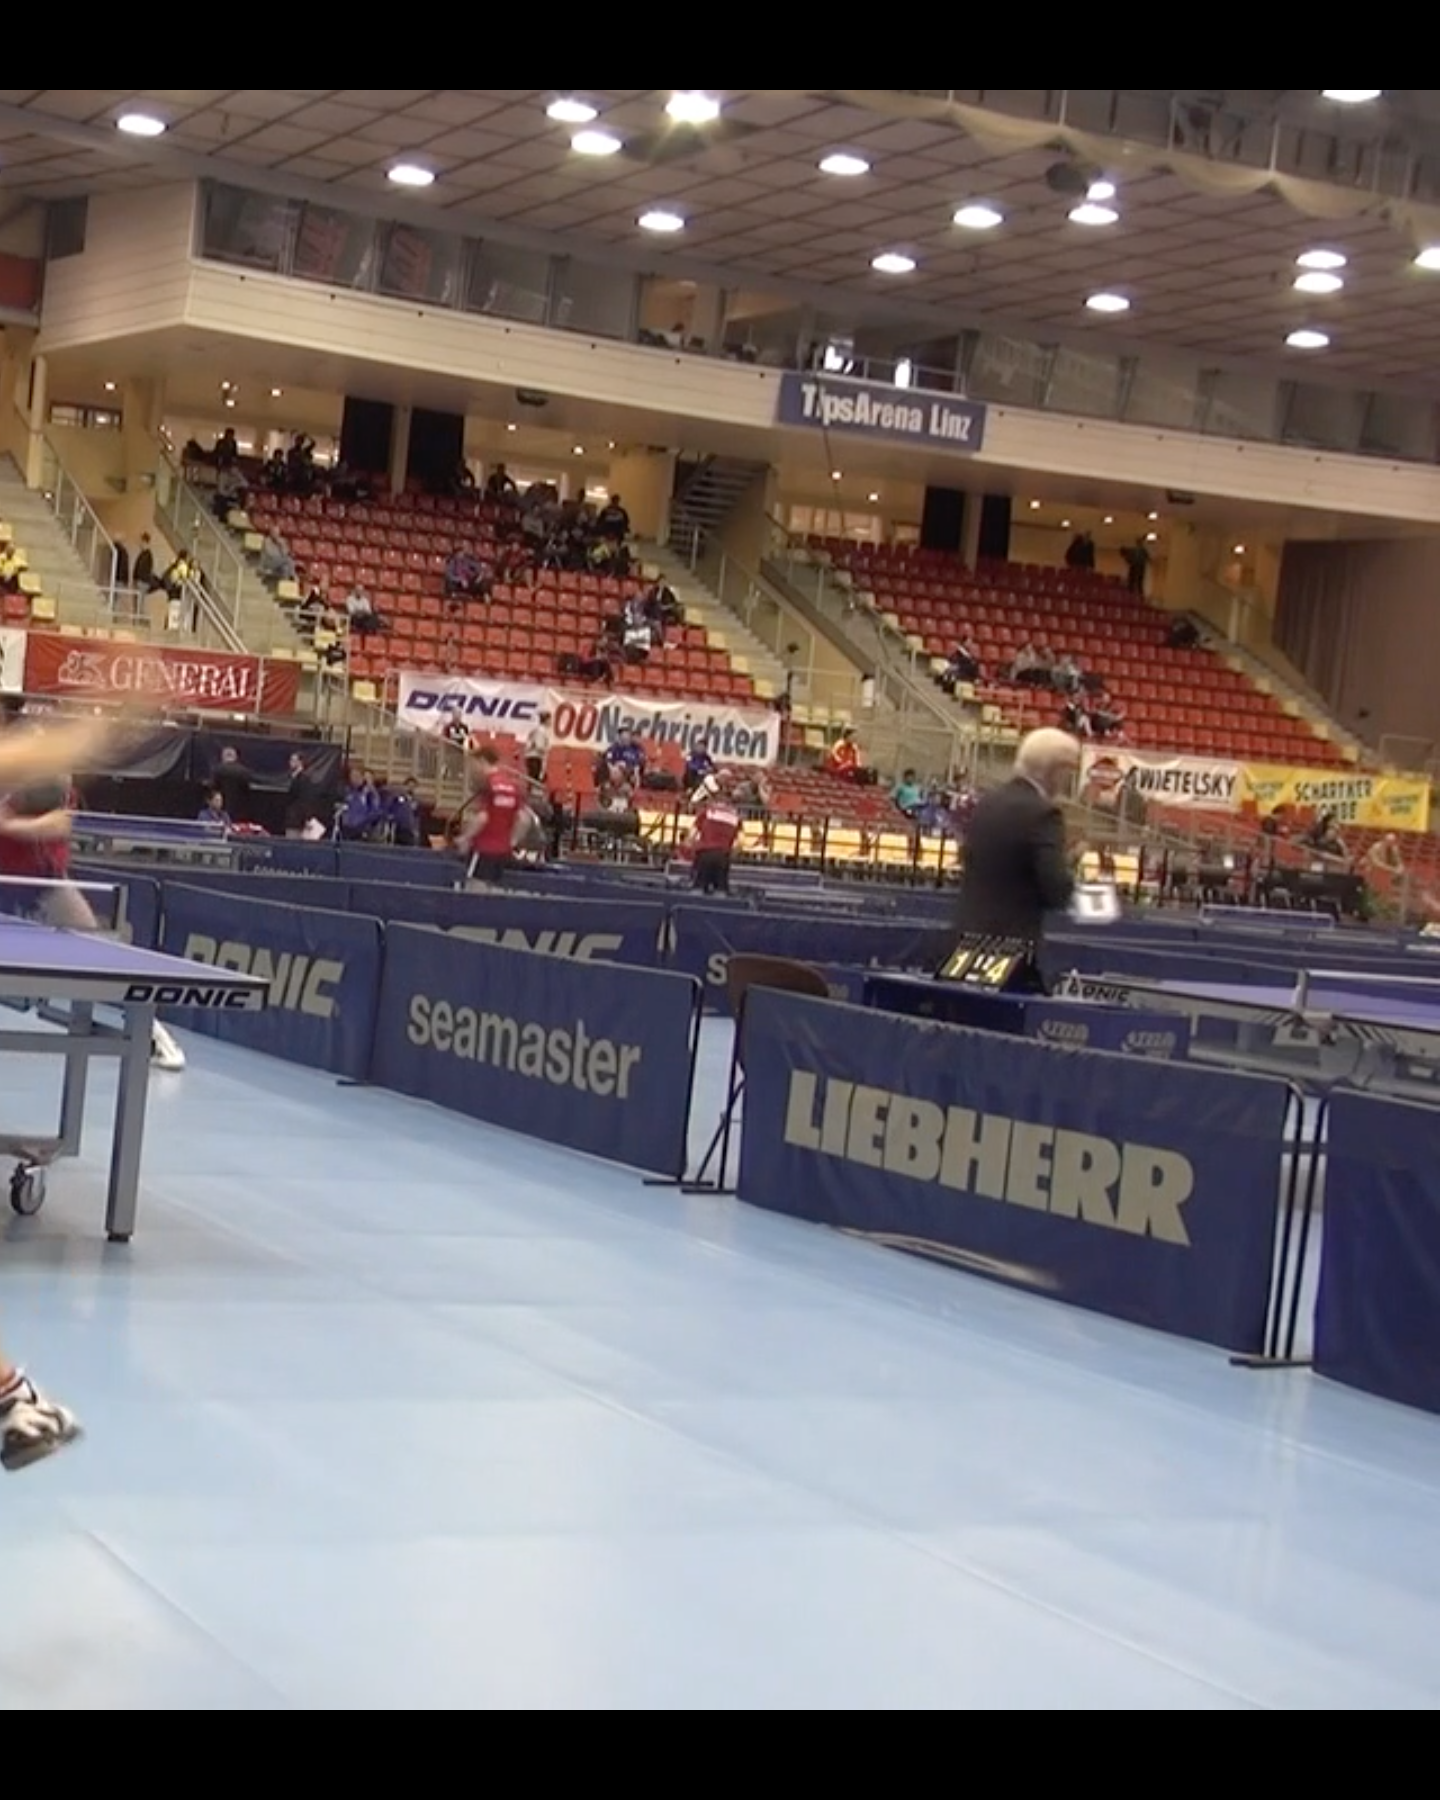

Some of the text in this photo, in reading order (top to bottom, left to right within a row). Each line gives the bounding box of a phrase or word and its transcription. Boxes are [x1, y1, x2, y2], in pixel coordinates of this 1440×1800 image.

[801, 383, 972, 441] TipsArena Linz
[1138, 767, 1237, 798] WIETELSKY
[123, 984, 251, 1009] DONIC
[407, 994, 641, 1099] seamaster
[784, 1069, 1195, 1247] LIEBHERR
